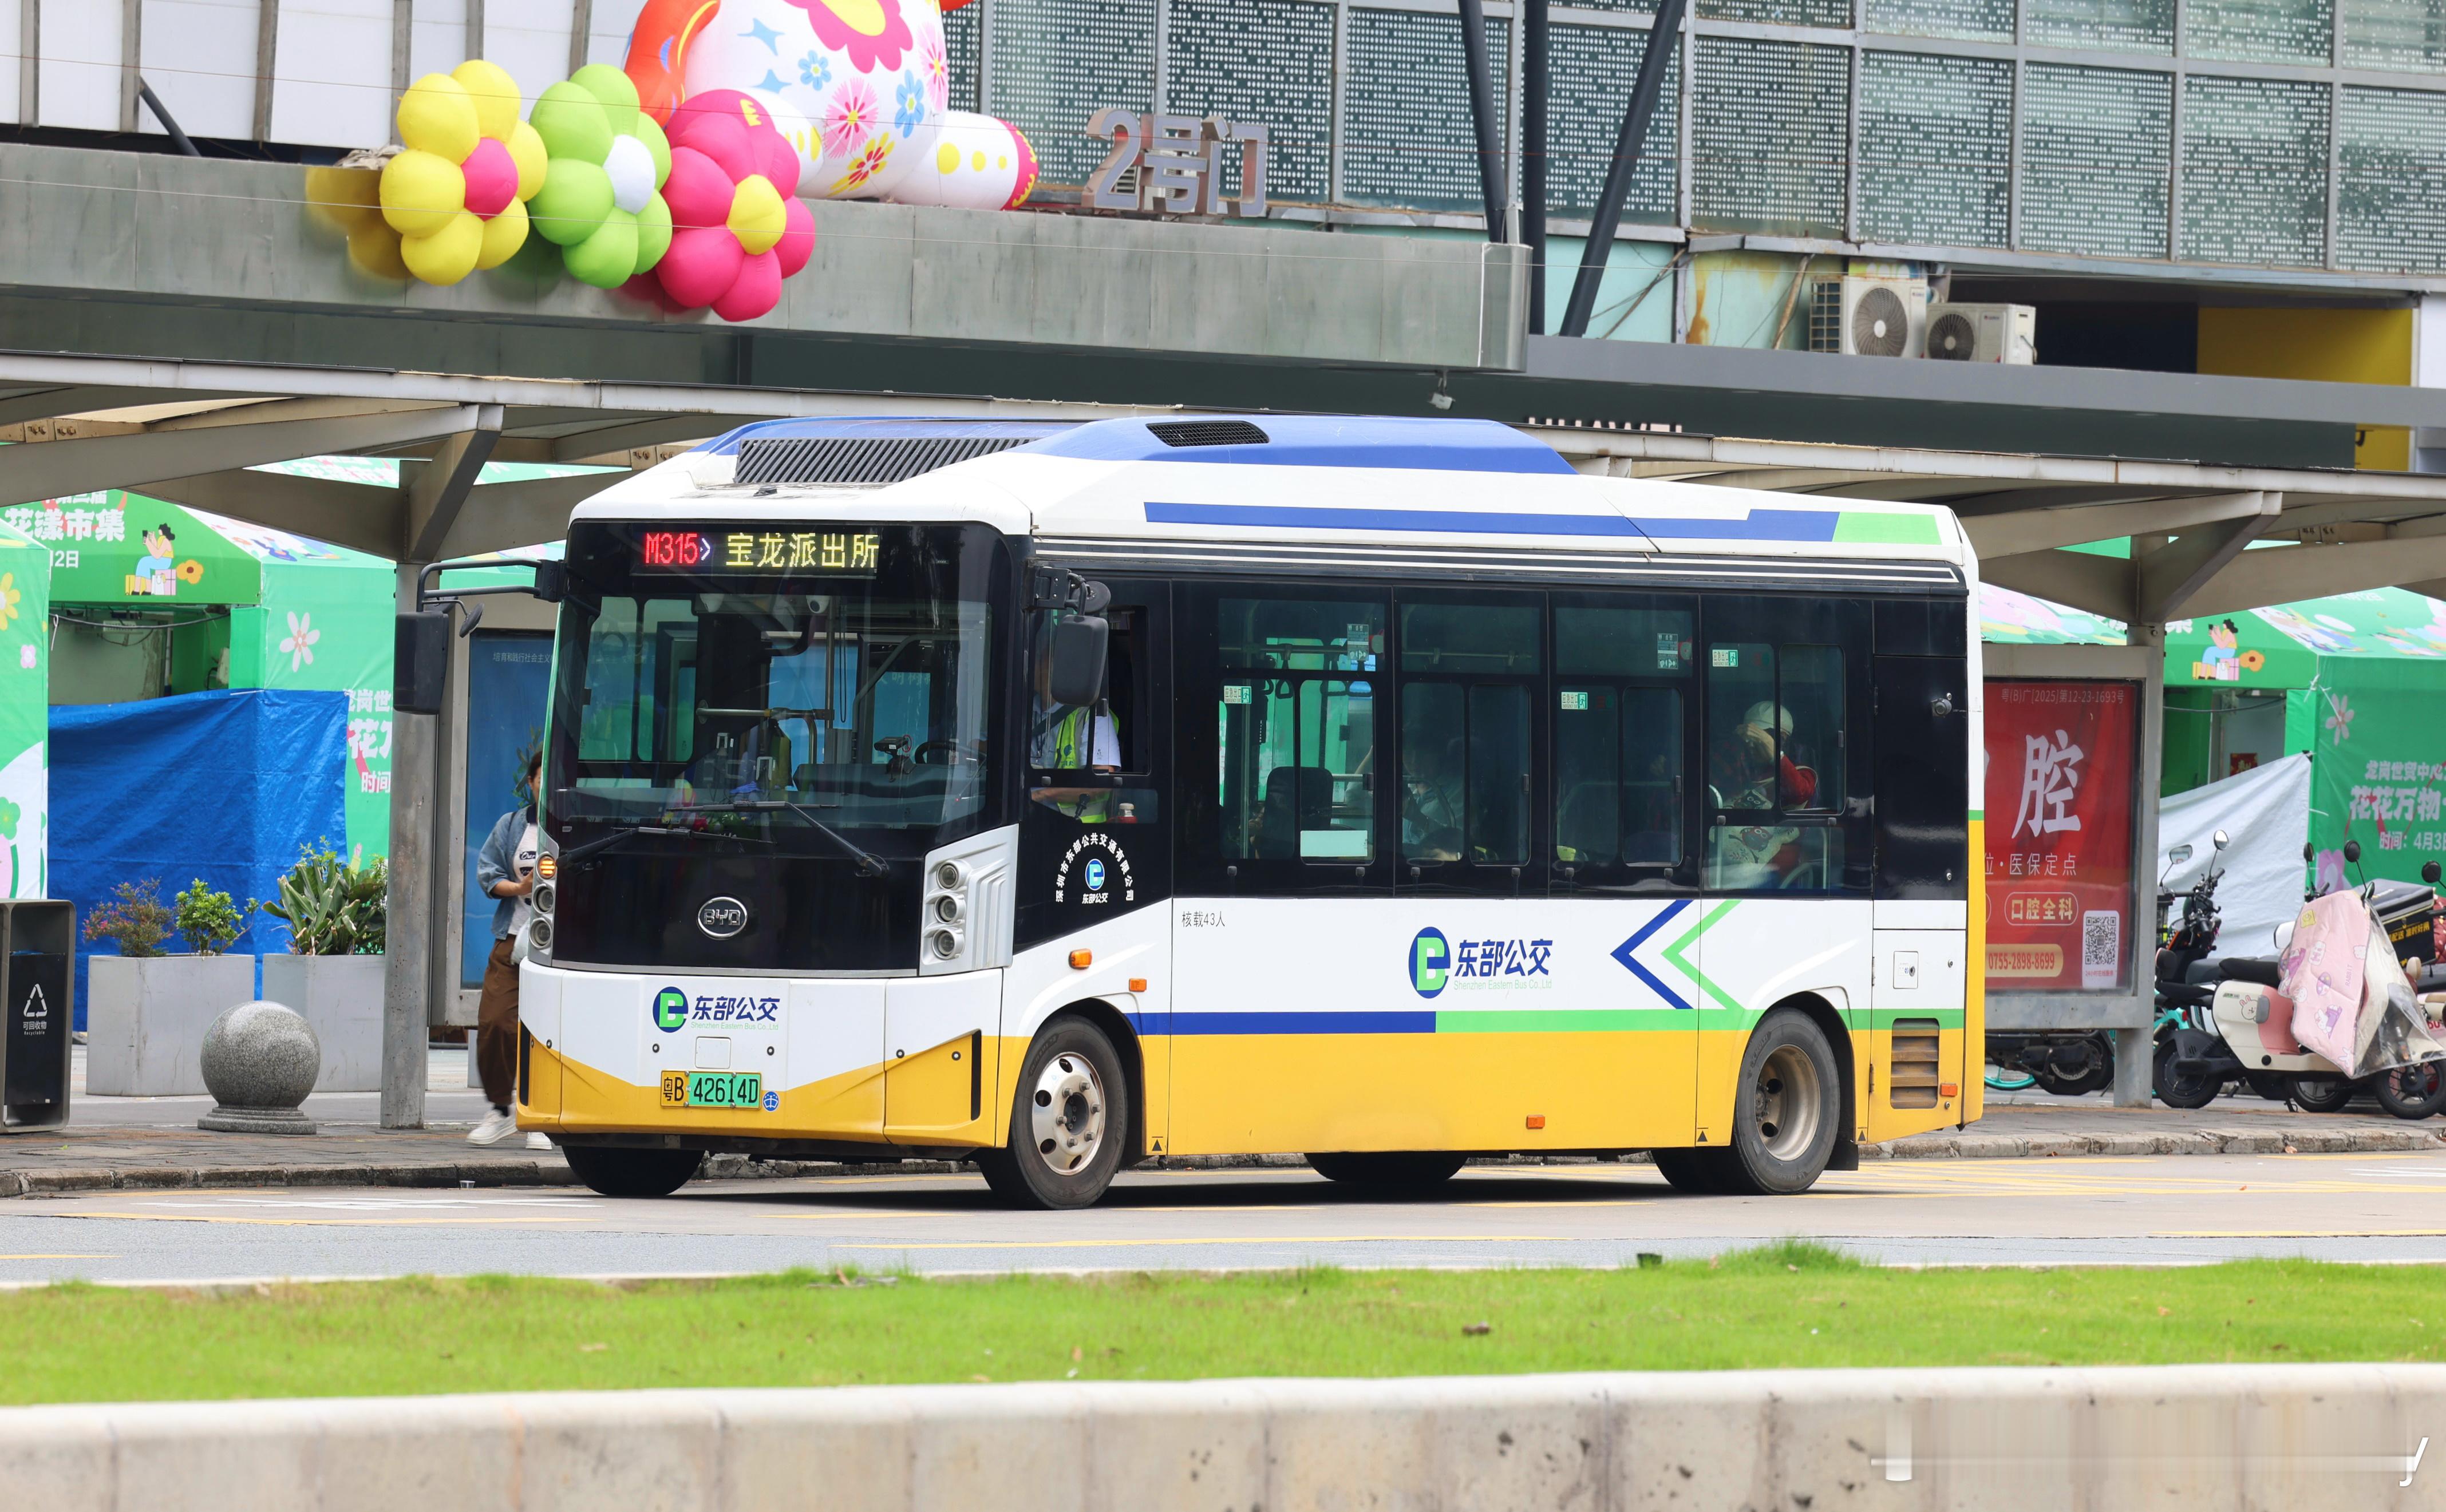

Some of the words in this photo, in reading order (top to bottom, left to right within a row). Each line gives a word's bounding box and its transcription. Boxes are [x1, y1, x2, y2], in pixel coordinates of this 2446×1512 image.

[1082, 108, 1269, 217] 2号门
[645, 533, 698, 564] M315
[726, 533, 879, 568] 宝龙派出所
[493, 652, 553, 663] 培育和践行社会主义
[2365, 760, 2446, 781] 龙岗世贸中心
[1985, 730, 2084, 839] 腔
[2350, 785, 2446, 821] 花花万物
[1056, 833, 1134, 903] 深圳市东部公共交通有限公司
[1082, 893, 1108, 904] 东部公交
[2011, 897, 2073, 920] 口腔全科
[704, 909, 740, 925] BYD
[1181, 911, 1225, 928] 核载43人
[1455, 939, 1553, 977] 东部公交
[1989, 952, 2055, 970] 0755-2898-8699
[1453, 980, 1486, 990] Shenzhen
[1488, 980, 1513, 989] Eastern
[1515, 979, 1527, 989] Bus
[691, 995, 780, 1022] 东部公交
[23, 1020, 47, 1030] 可回收物
